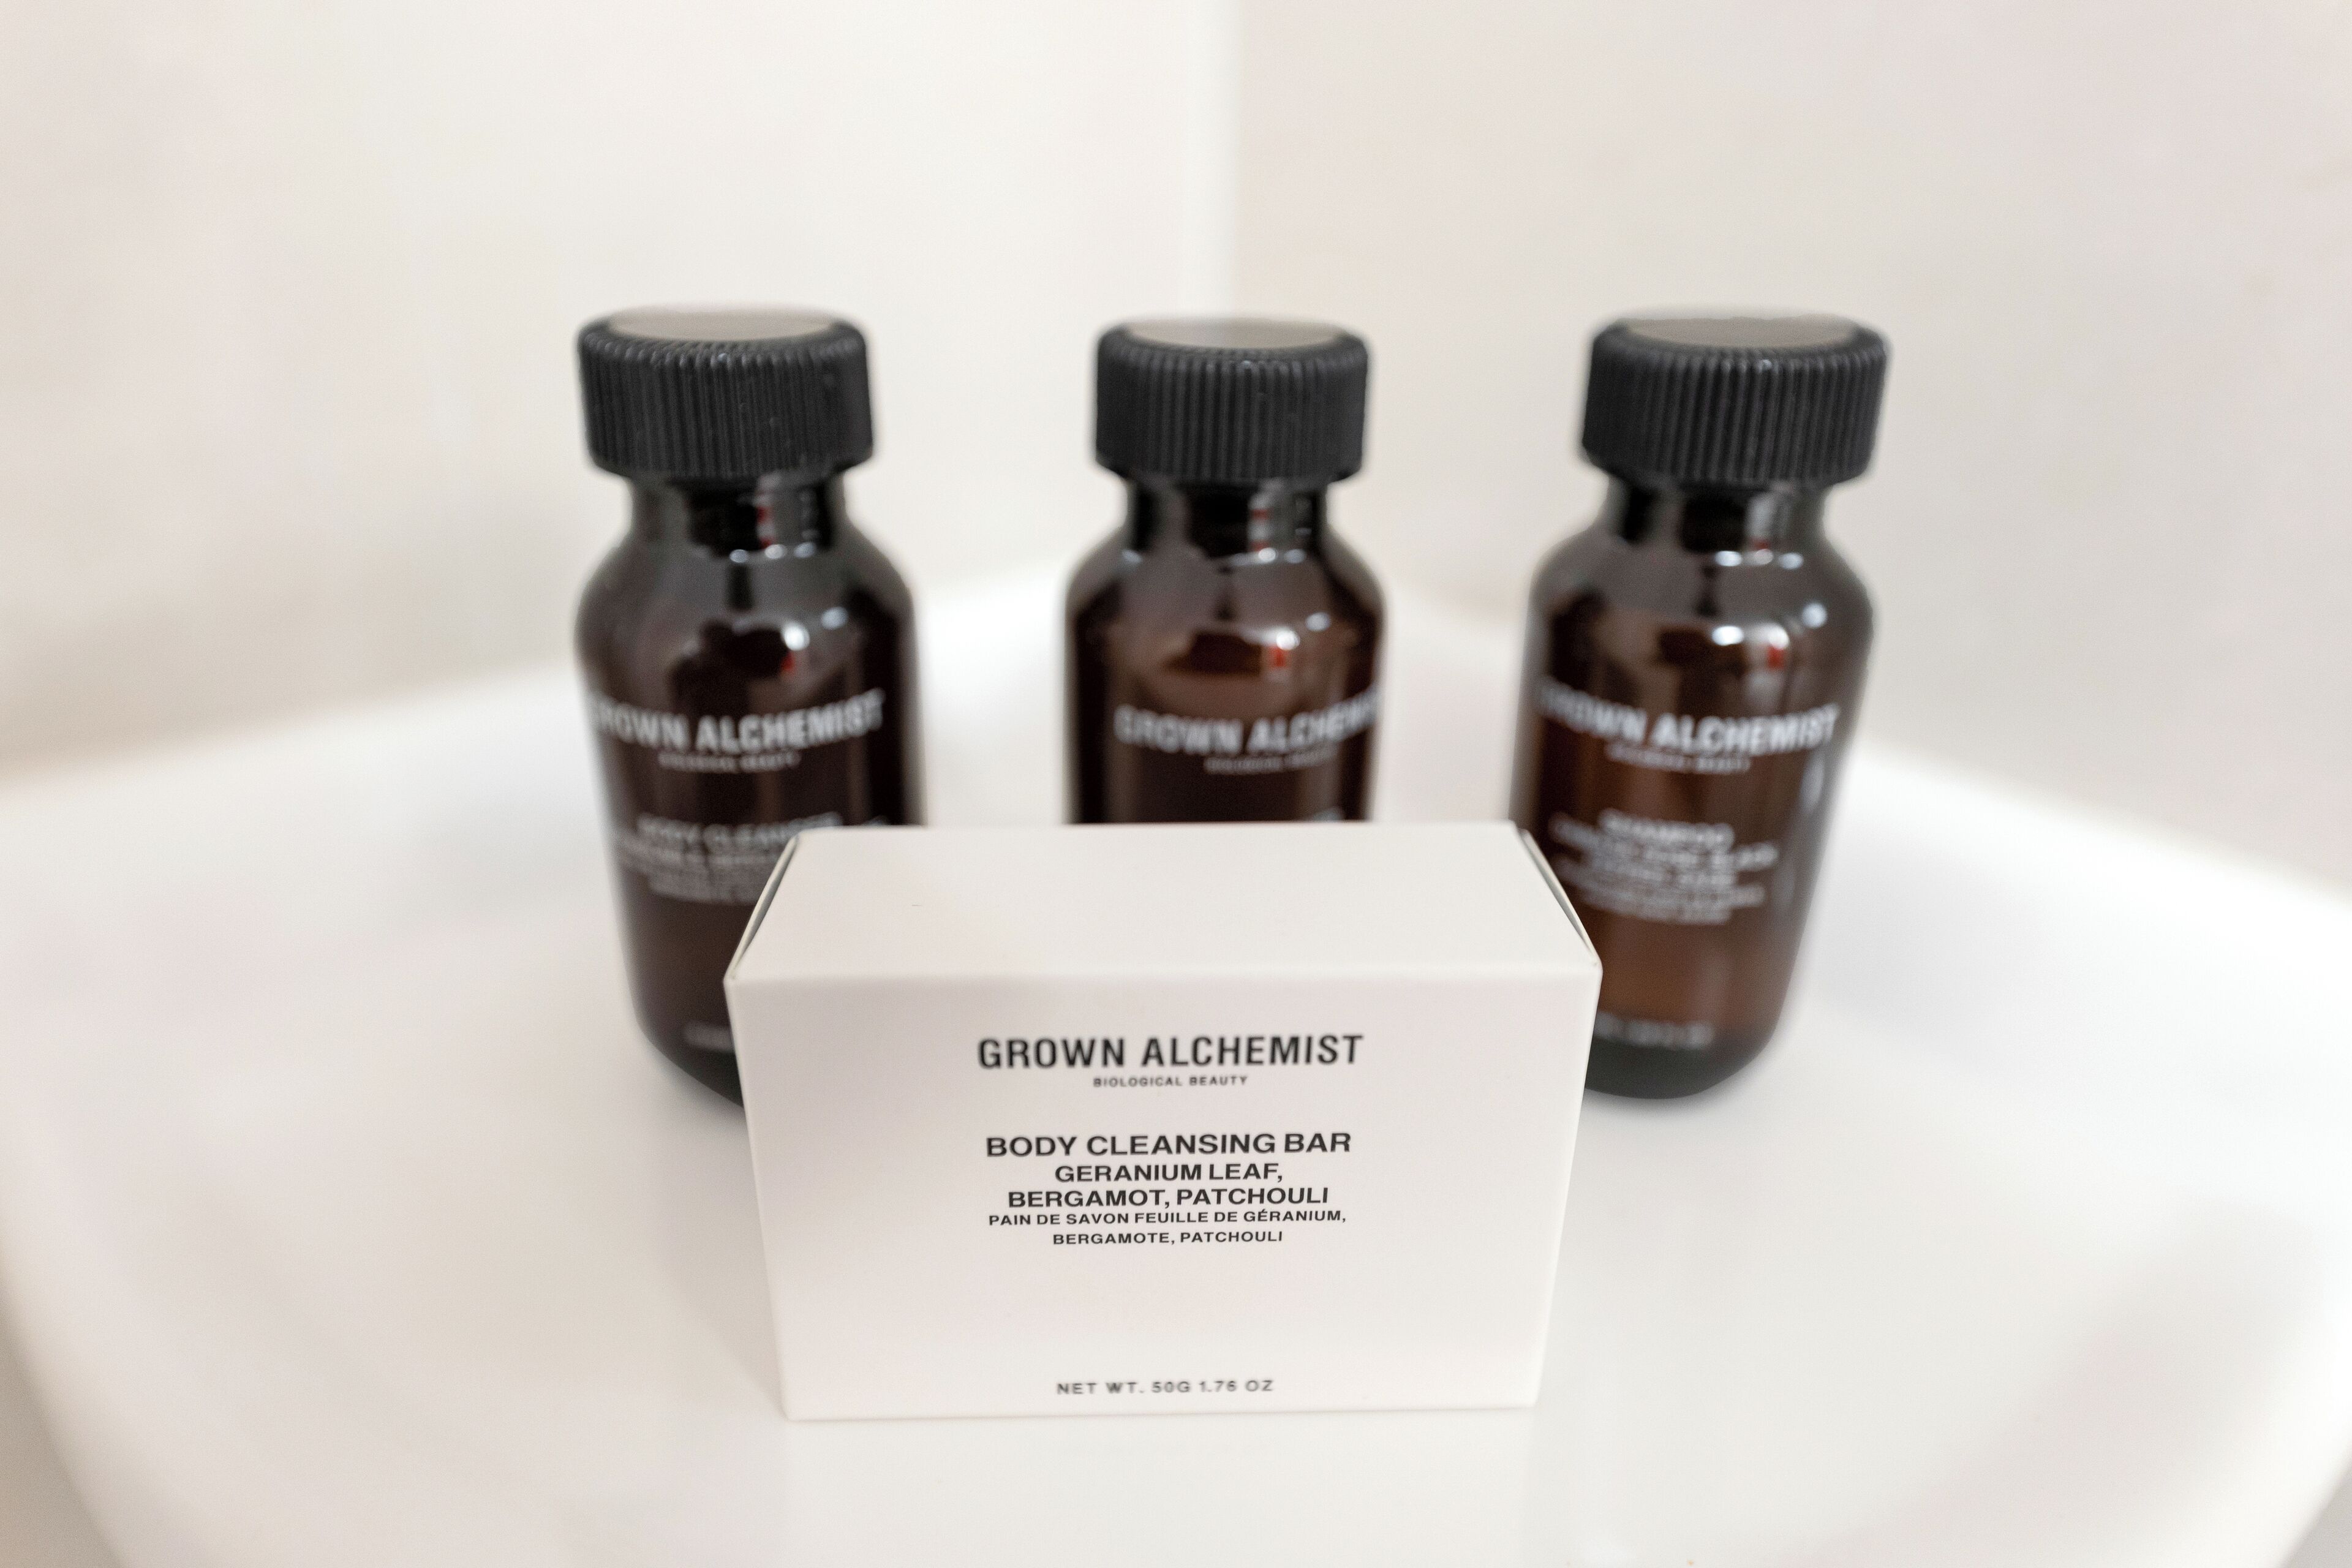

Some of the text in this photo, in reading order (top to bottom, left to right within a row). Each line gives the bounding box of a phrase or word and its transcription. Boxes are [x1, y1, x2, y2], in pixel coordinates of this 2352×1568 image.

[696, 688, 884, 754] ALCHEMIST
[1114, 704, 1243, 755] GROWN
[1652, 704, 1839, 755] ALCHEMIST
[976, 1034, 1365, 1070] GROWN ALCHEMIST
[1093, 1075, 1248, 1088] BIOLOGICAL BEAUTY
[986, 1132, 1351, 1158] BODY CLEANSING BAR
[1054, 1163, 1283, 1183] GERANIUM LEAF,
[1008, 1187, 1329, 1209] BERGAMOT, PATCHOULI
[989, 1208, 1346, 1226] PAIN DE SAVON FEUILLE DE GÉRANIUM,
[1053, 1231, 1283, 1245] BERGAMOTE, PATCHOULI
[1057, 1379, 1273, 1395] NET WT. 50G 1.76 OZ
